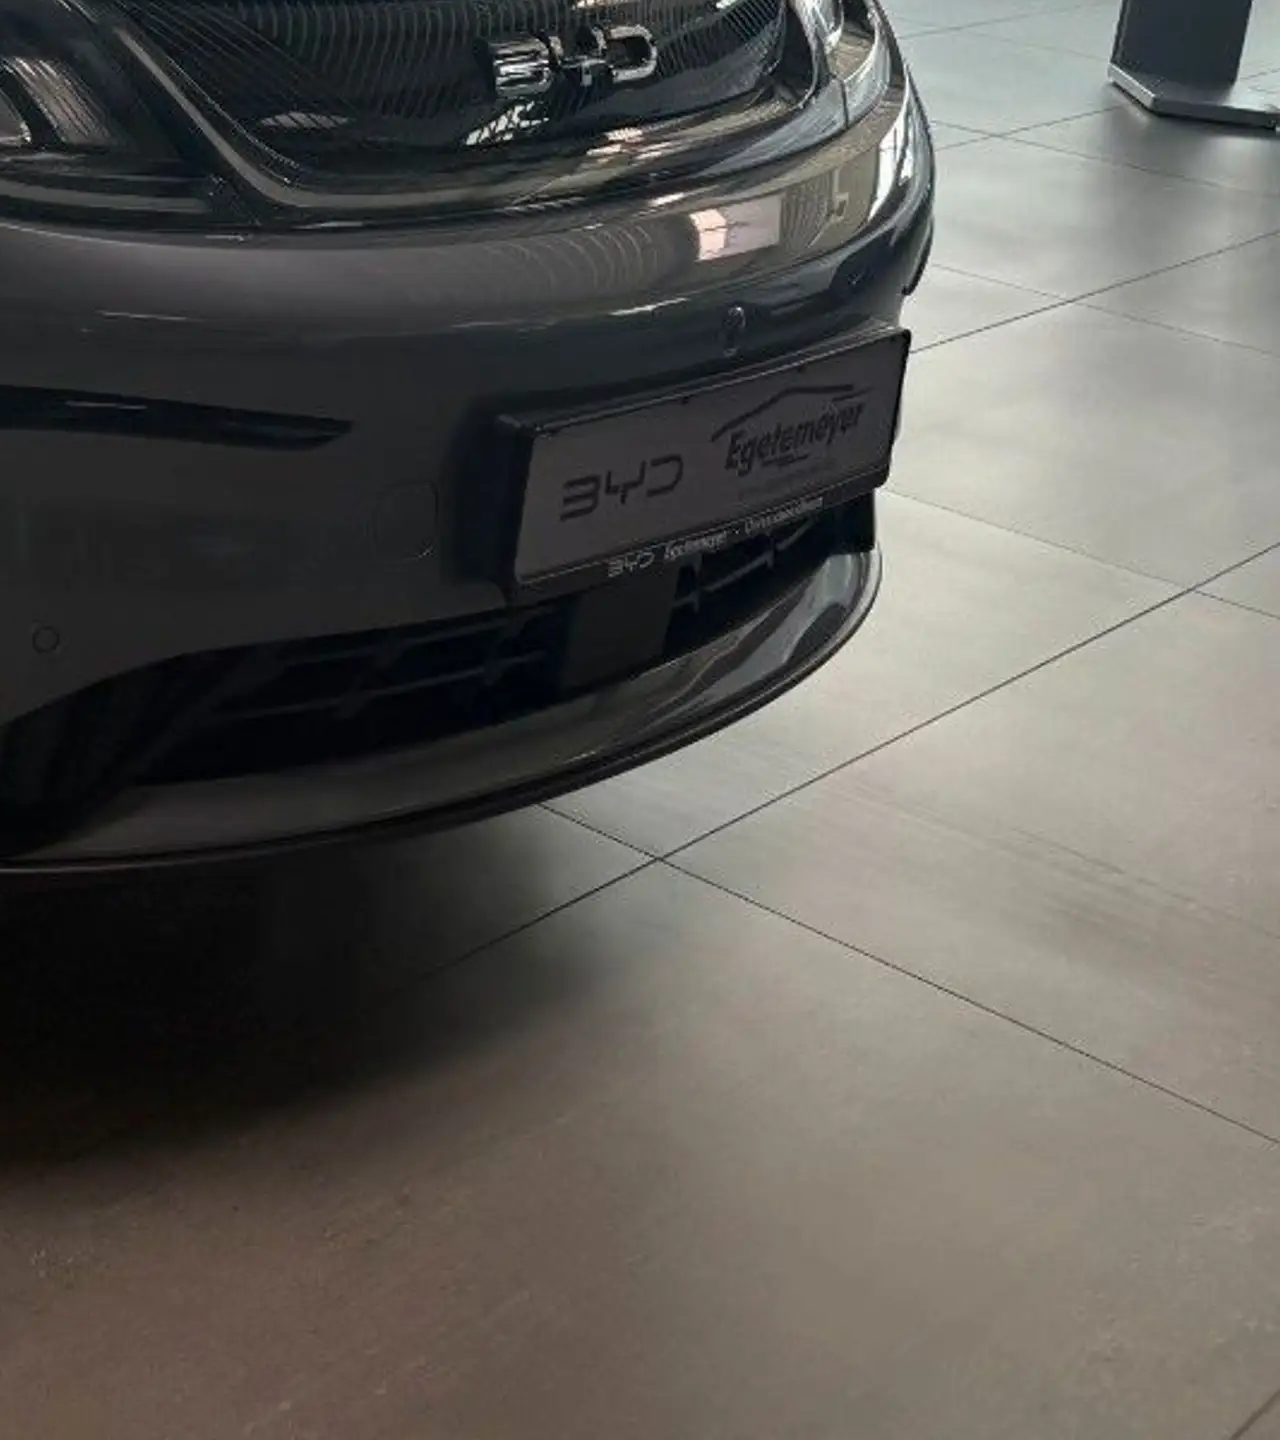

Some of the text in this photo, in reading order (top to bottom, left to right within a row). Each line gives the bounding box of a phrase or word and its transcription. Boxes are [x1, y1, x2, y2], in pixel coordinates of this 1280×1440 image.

[493, 24, 657, 99] BYD
[723, 402, 865, 478] Egetemeyer
[559, 453, 684, 522] BYD
[607, 550, 655, 578] BYD
